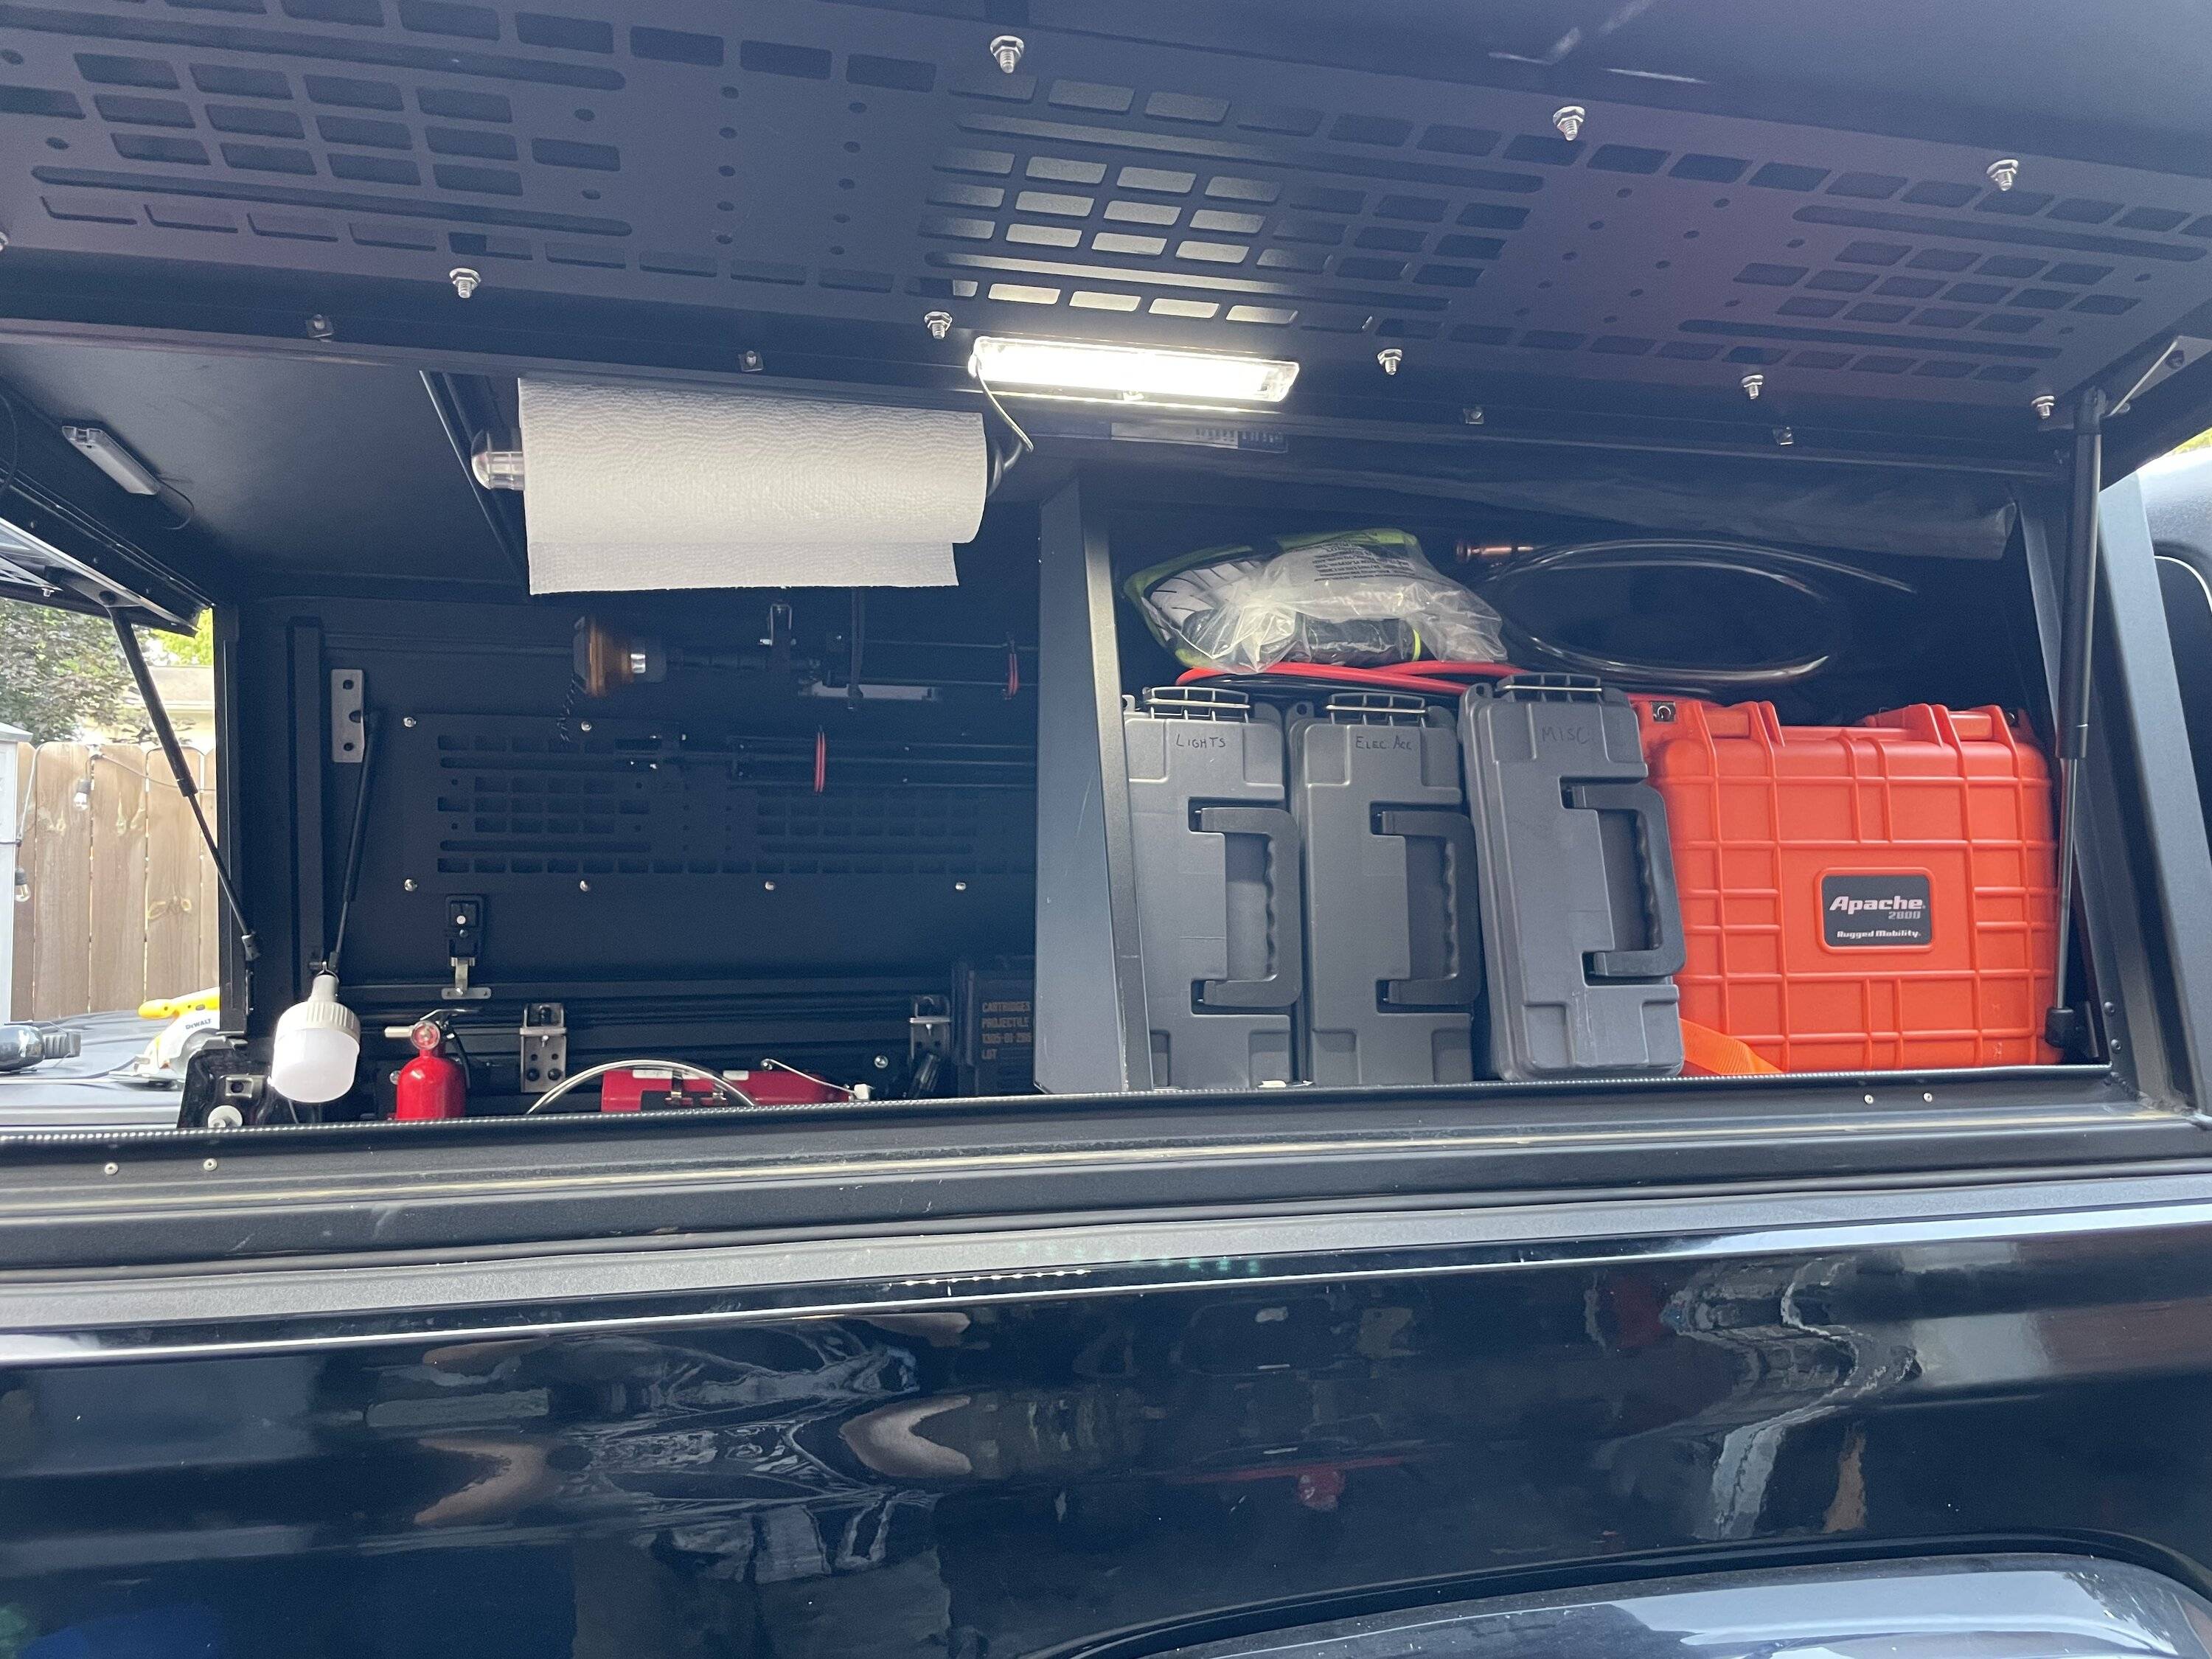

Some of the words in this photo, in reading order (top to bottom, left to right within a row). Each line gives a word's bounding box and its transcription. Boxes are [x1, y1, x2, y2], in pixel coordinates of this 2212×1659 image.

[1176, 734, 1226, 748] LIGHTS
[1829, 896, 1924, 914] Apache
[1837, 931, 1874, 939] Rugged
[1876, 930, 1919, 938] Mobility
